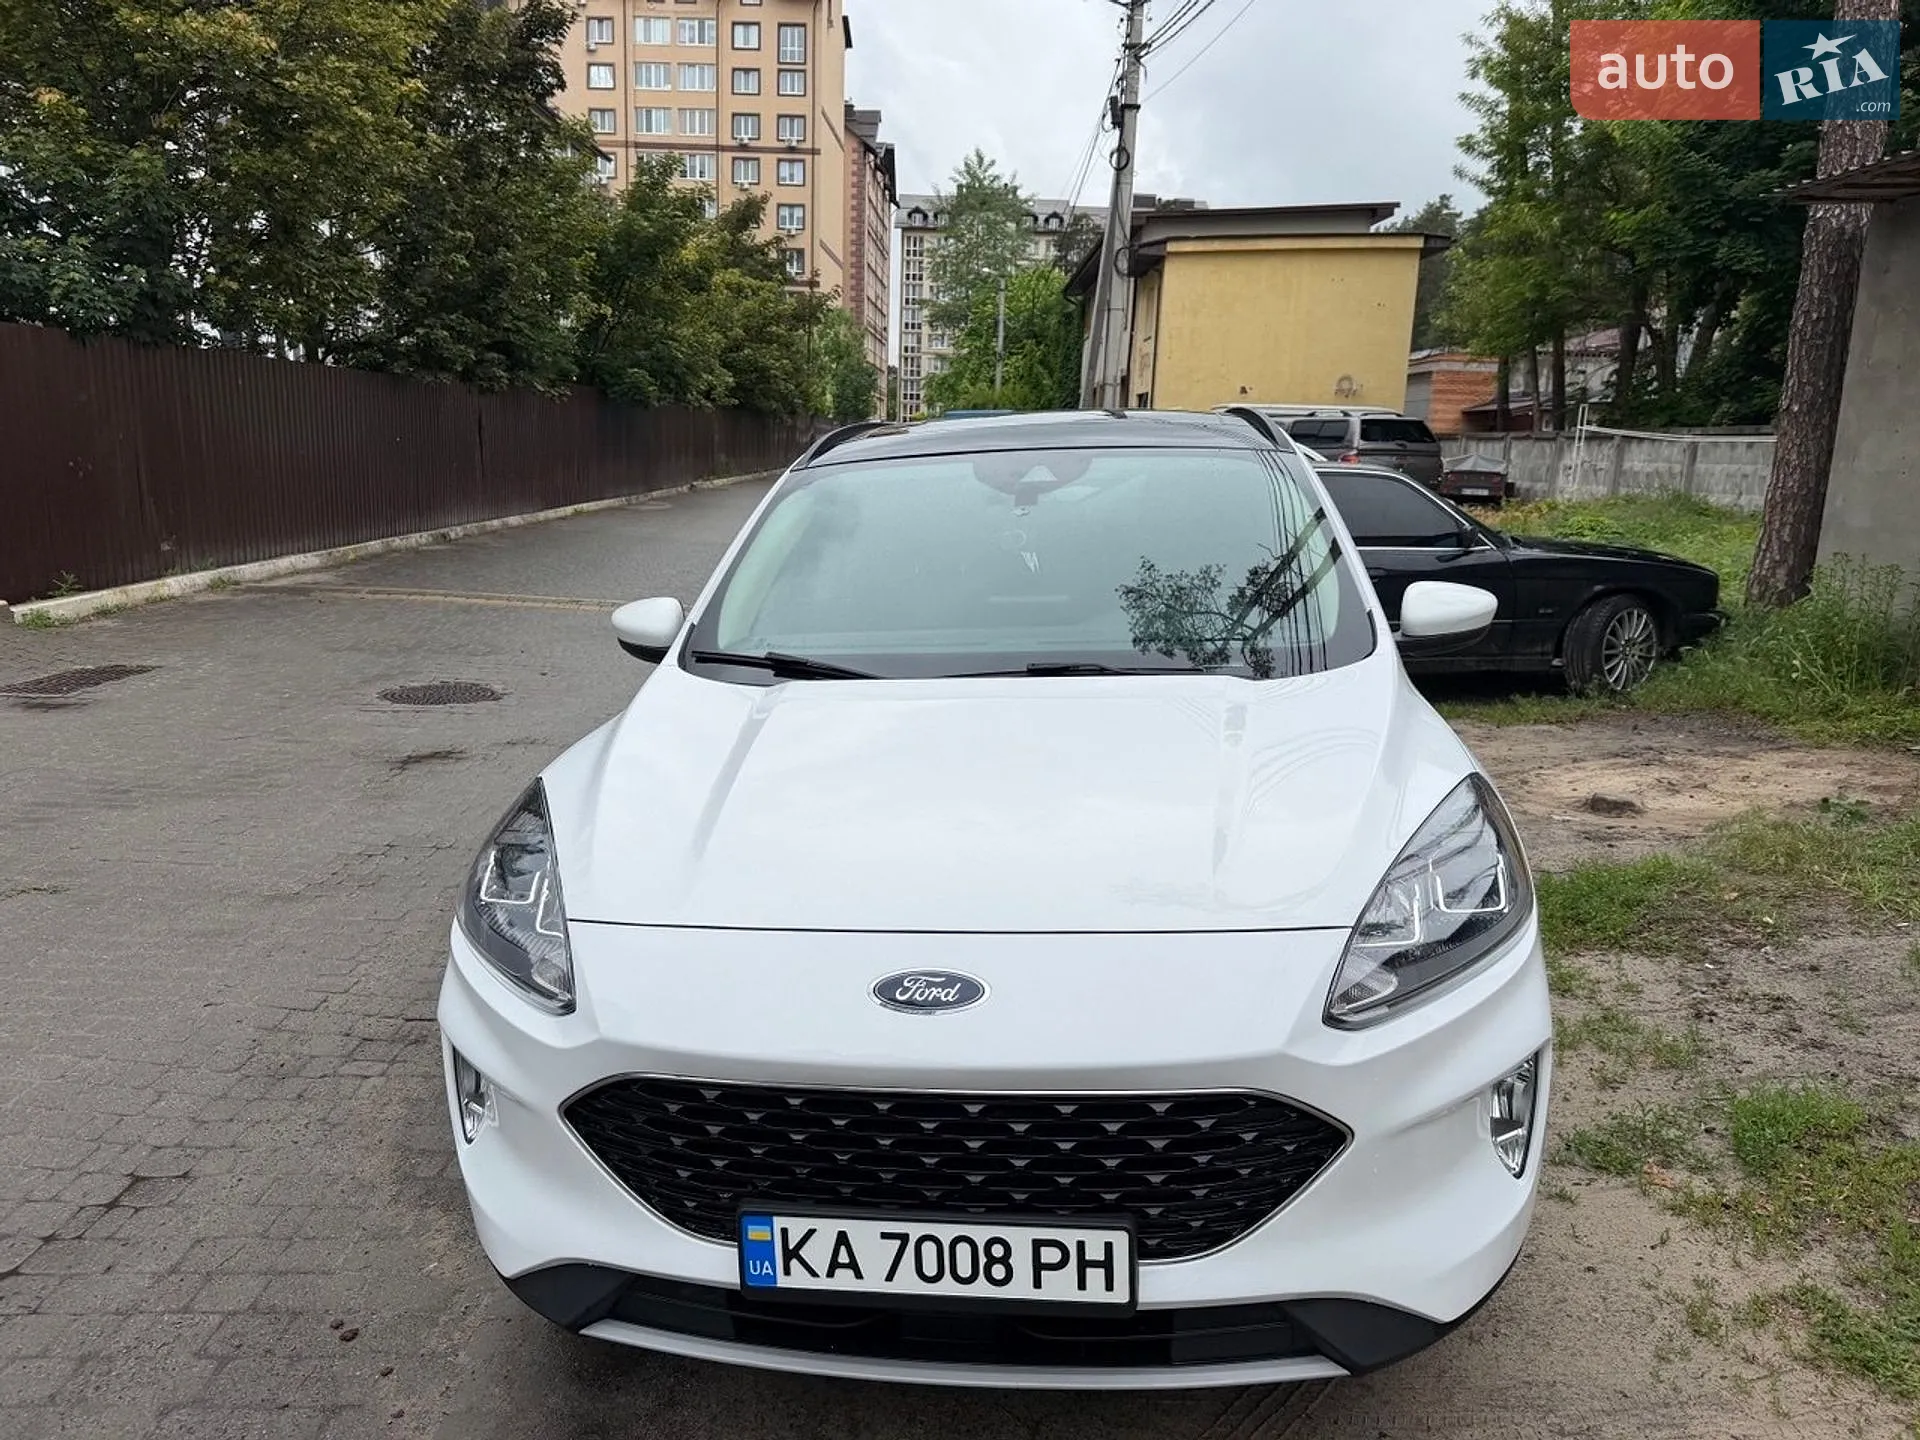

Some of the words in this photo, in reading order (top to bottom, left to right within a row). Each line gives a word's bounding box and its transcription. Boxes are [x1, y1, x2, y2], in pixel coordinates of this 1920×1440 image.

[895, 976, 961, 1002] Ford
[749, 1260, 774, 1276] UA
[780, 1227, 863, 1280] KA
[880, 1231, 1014, 1287] 7008
[1032, 1238, 1114, 1292] PH
